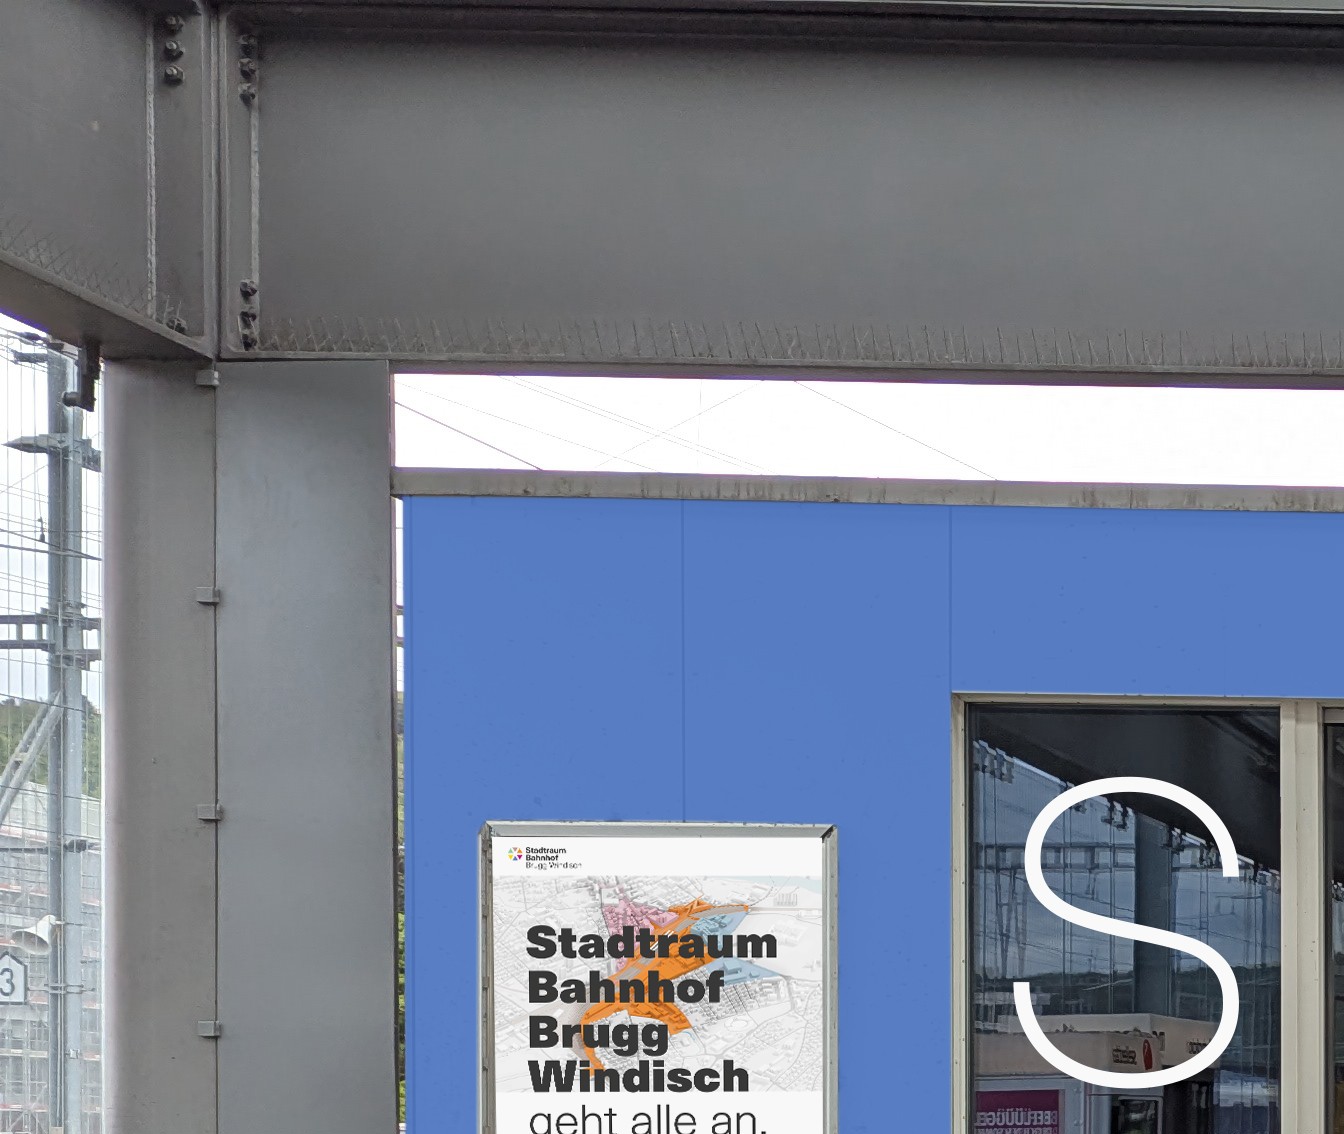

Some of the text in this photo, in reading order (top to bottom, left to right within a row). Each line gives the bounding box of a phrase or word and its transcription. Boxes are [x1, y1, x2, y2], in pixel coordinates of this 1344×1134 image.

[526, 925, 777, 959] Stadtraum
[529, 970, 724, 1004] Bahnhof
[529, 1015, 668, 1056] Brugg
[528, 1060, 749, 1093] Windisch
